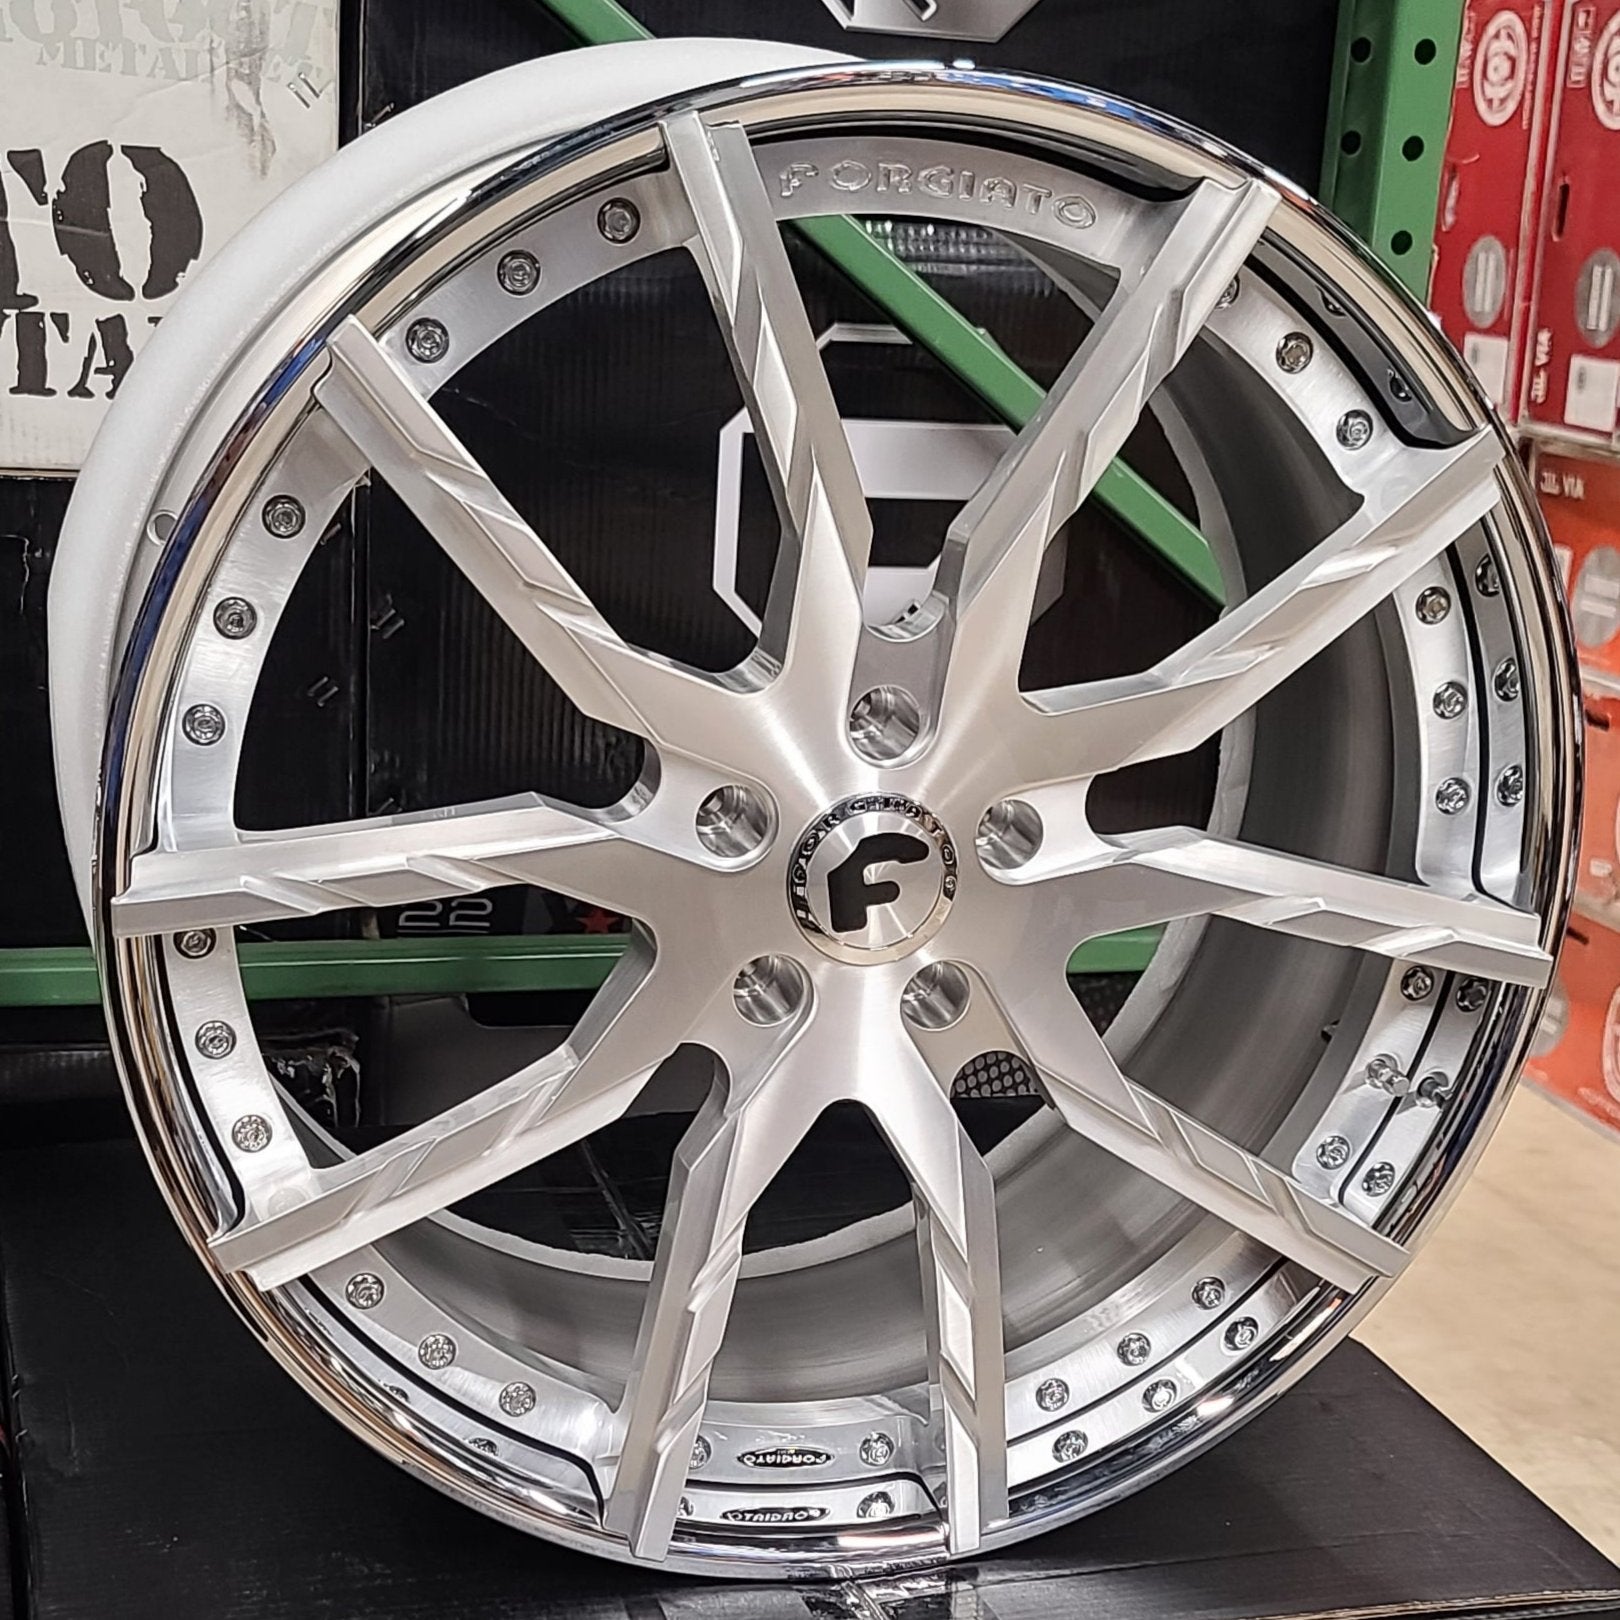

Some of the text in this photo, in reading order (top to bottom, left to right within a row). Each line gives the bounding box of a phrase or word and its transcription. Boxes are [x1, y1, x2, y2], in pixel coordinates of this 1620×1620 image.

[779, 160, 1097, 229] FORGIATO
[0, 312, 164, 399] TA
[398, 898, 494, 927] 22
[743, 1453, 827, 1466] FORGIATO
